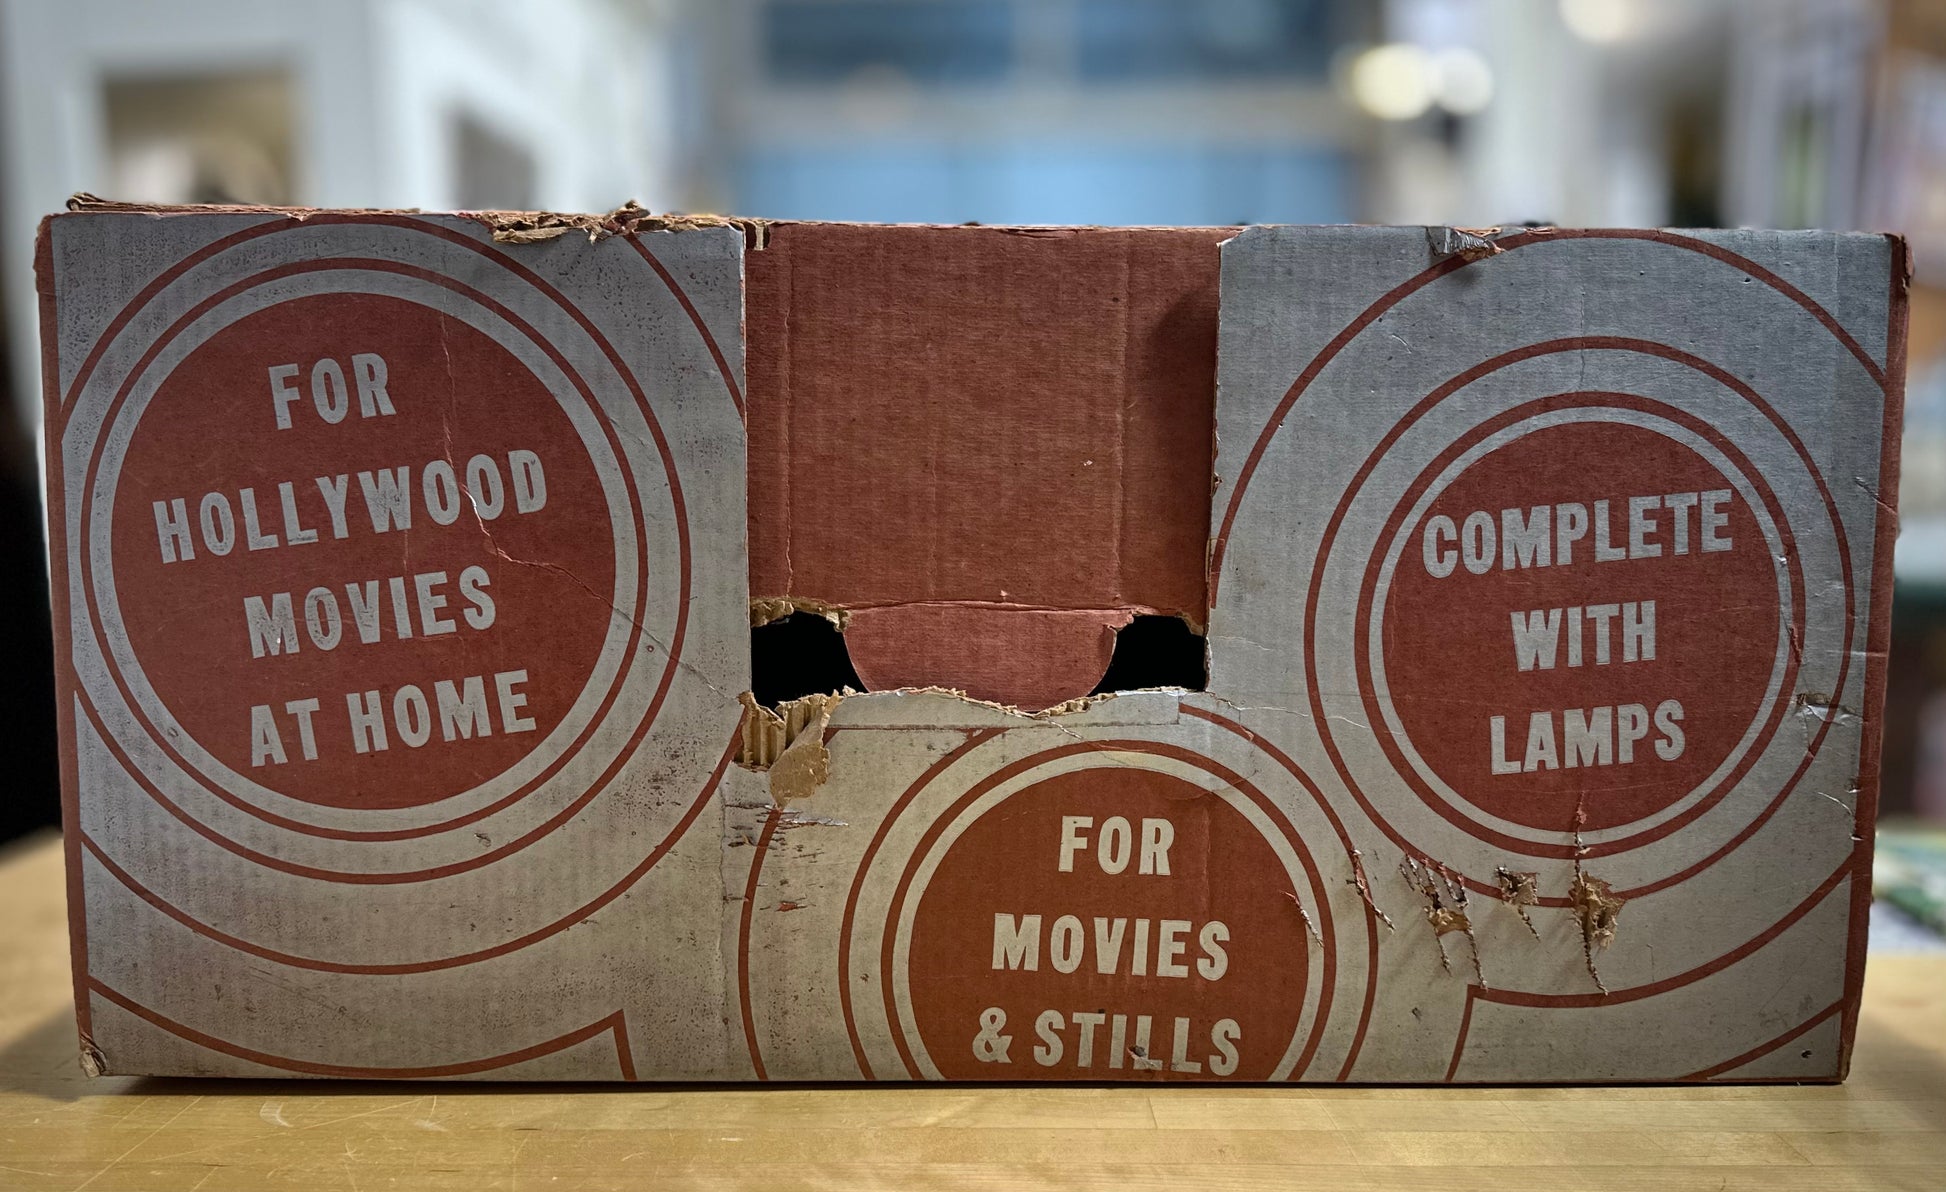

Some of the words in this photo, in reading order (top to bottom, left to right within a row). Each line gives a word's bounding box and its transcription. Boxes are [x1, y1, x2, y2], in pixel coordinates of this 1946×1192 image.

[267, 351, 398, 432] FOR
[152, 448, 548, 565] HOLLYWOOD
[1421, 487, 1734, 580] COMPLETE
[243, 565, 498, 659] MOVIES
[1509, 599, 1657, 674] WITH
[250, 698, 320, 768] AT
[346, 669, 537, 757] HOME
[1489, 699, 1687, 776] LAMPS
[1058, 814, 1175, 878] FOR
[991, 912, 1230, 981] MOVIES
[971, 1006, 1013, 1064] &
[1033, 1009, 1242, 1076] STILLS
